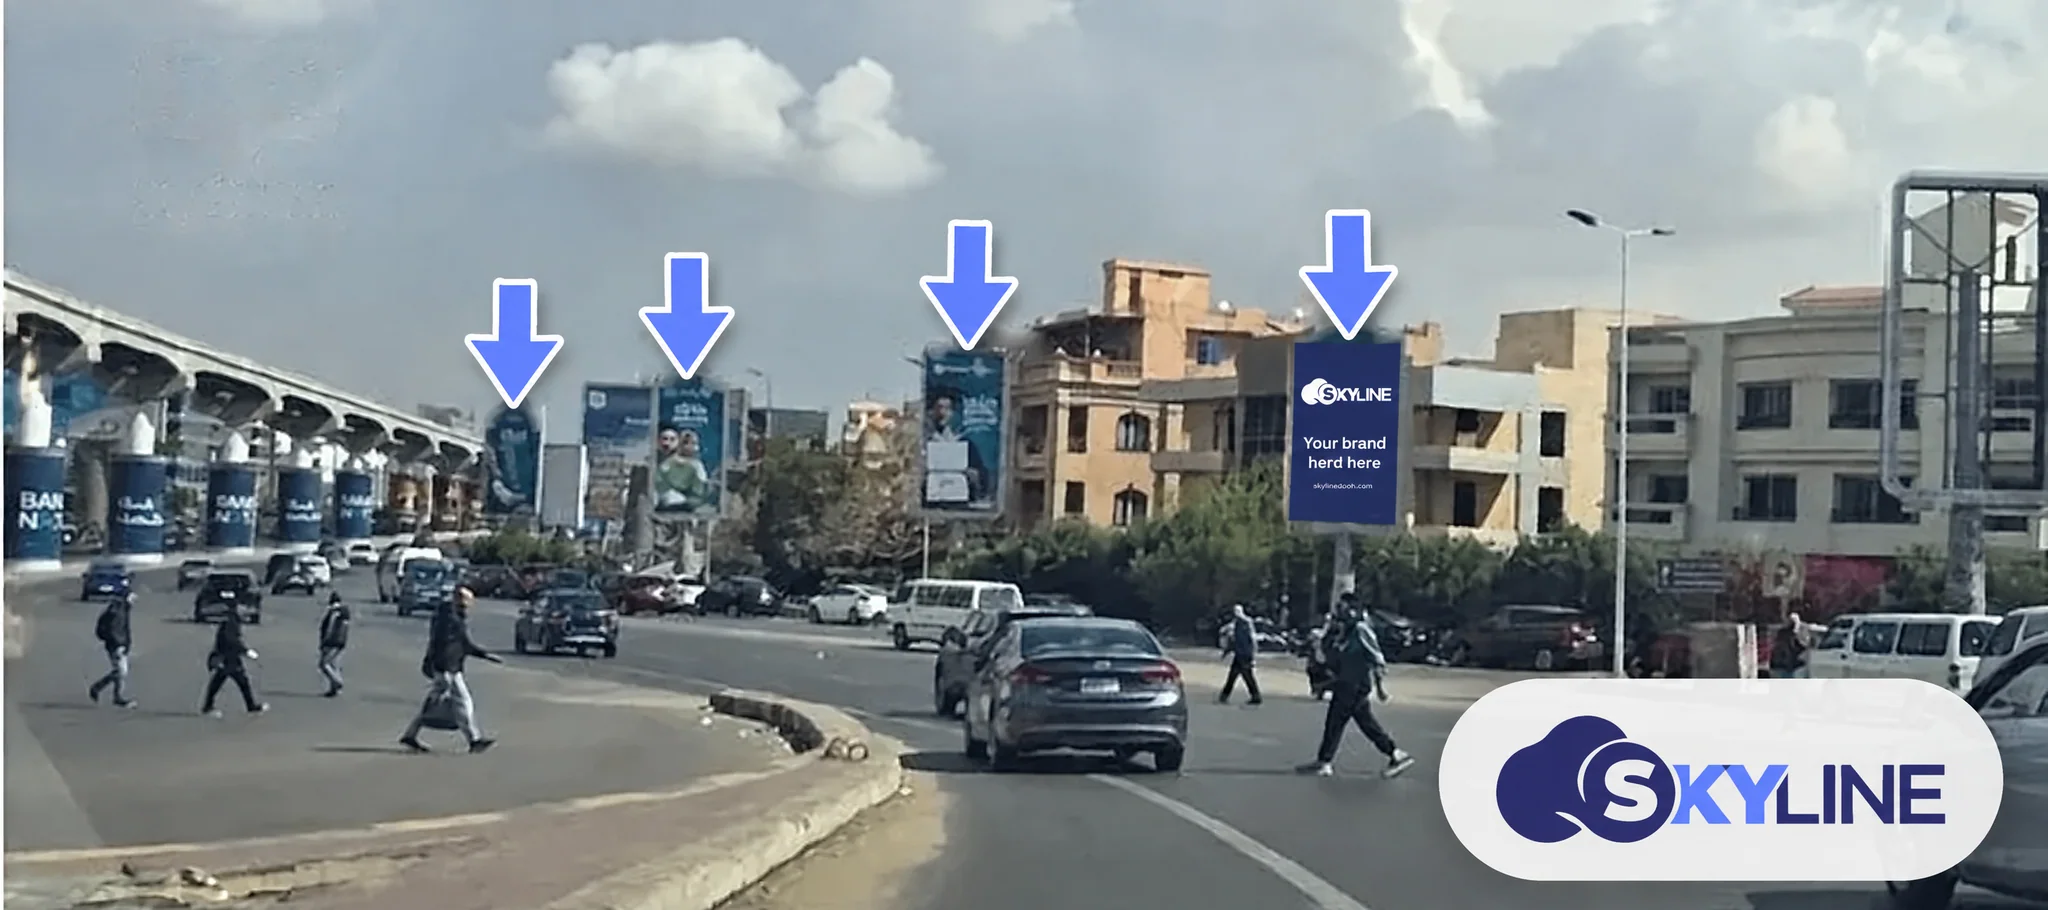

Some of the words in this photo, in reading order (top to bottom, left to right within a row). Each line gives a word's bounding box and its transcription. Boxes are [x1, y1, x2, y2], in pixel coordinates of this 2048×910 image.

[1322, 387, 1392, 402] SKYLINE
[1303, 436, 1338, 450] Your
[1342, 436, 1387, 450] brand
[1308, 456, 1343, 469] herd
[1347, 456, 1381, 469] here
